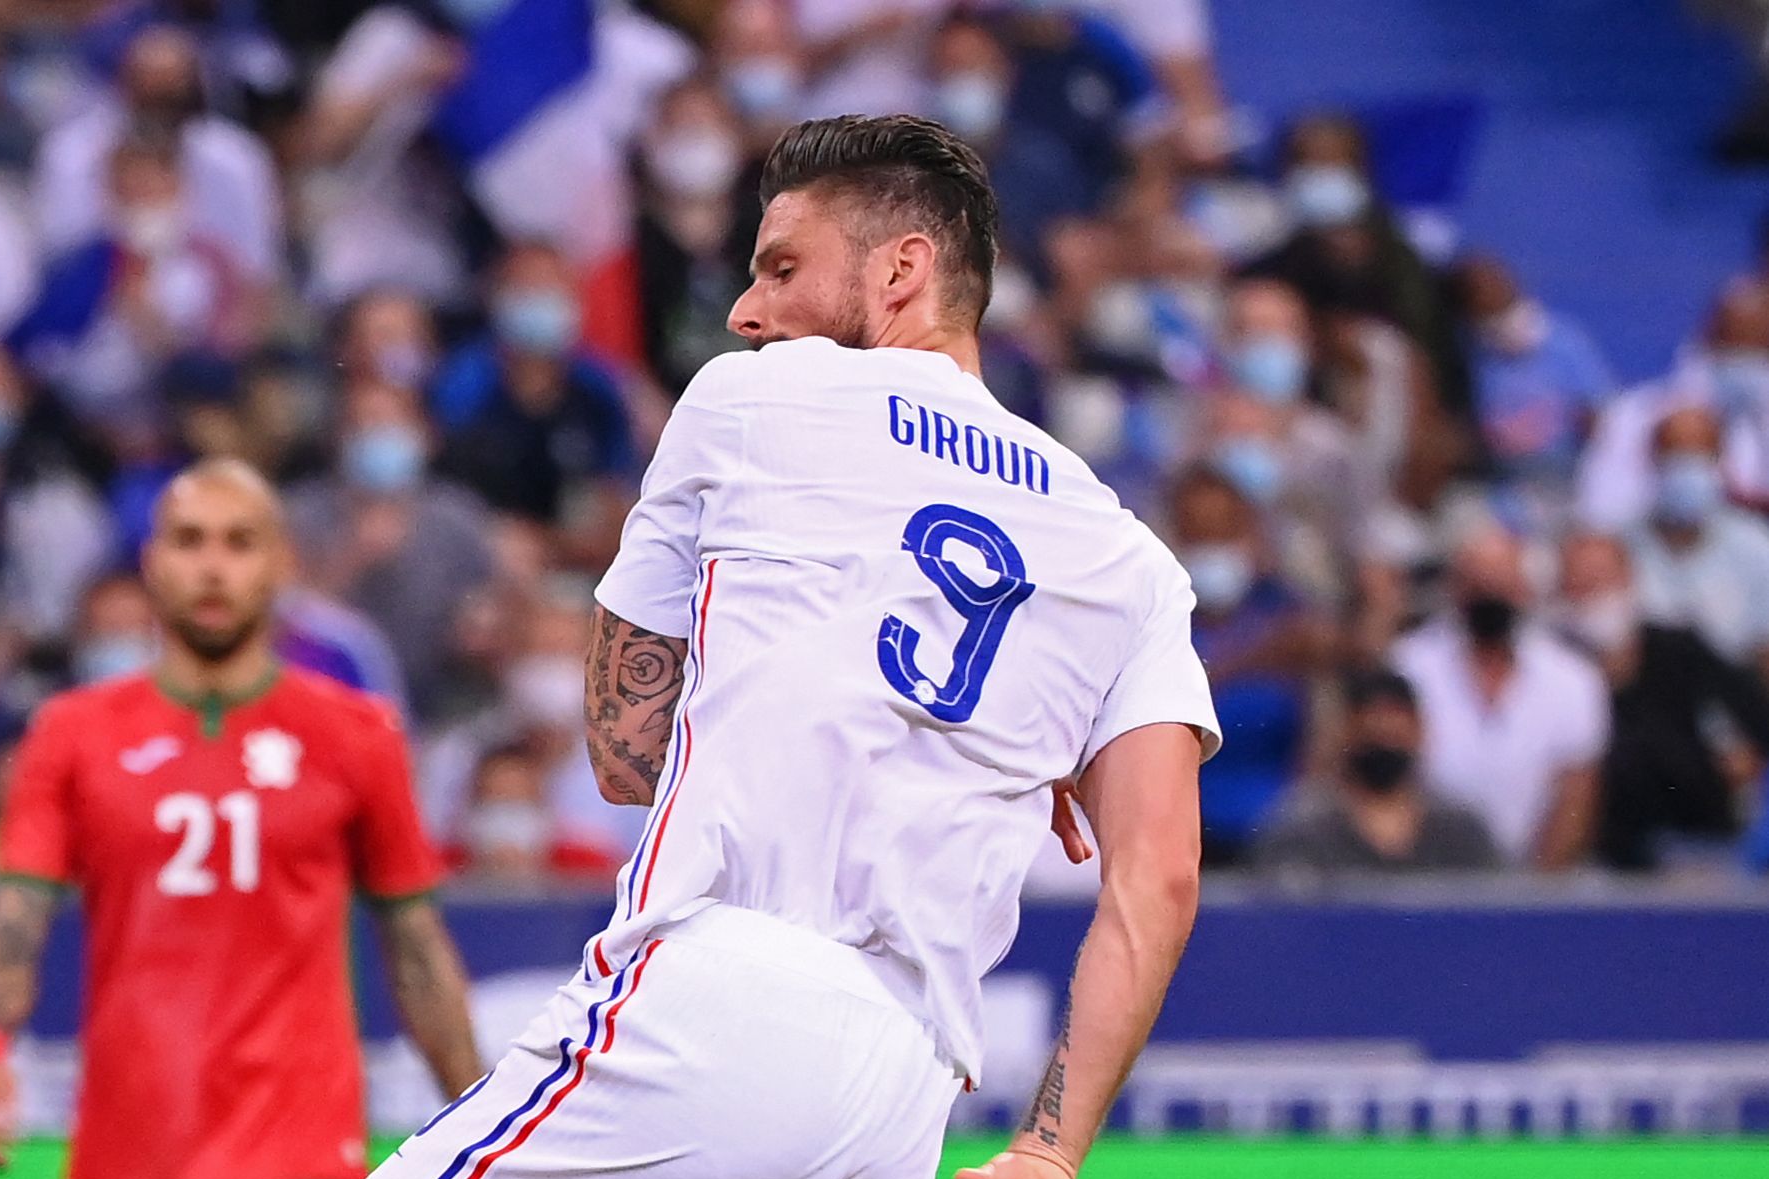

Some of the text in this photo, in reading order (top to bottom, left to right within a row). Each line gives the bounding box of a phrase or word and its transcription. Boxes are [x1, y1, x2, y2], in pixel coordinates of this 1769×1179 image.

[888, 395, 1049, 496] GIROUD
[877, 503, 1036, 723] 9
[154, 791, 260, 896] 21
